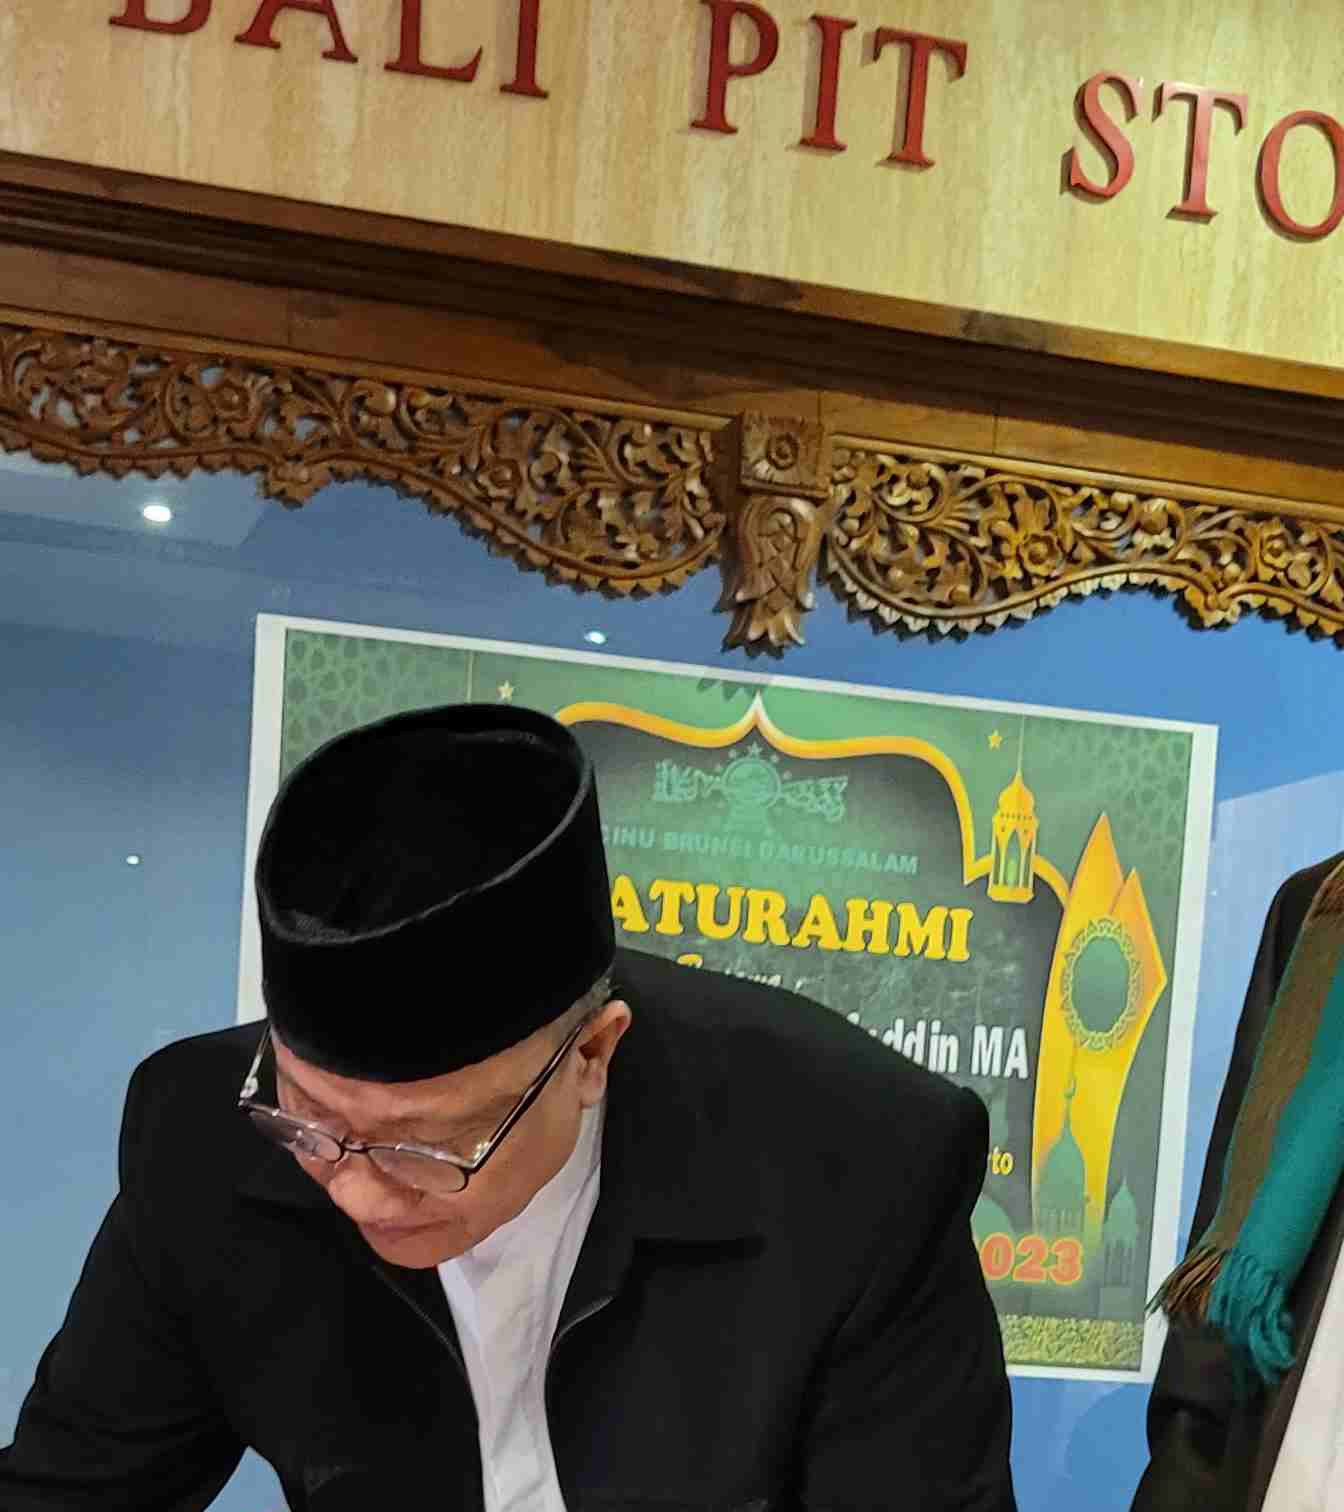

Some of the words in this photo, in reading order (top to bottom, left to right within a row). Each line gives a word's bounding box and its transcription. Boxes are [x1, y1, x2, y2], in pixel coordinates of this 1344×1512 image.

[109, 0, 549, 99] LI
[690, 0, 967, 168] PIT
[602, 824, 655, 848] INU
[970, 1025, 1029, 1079] MA
